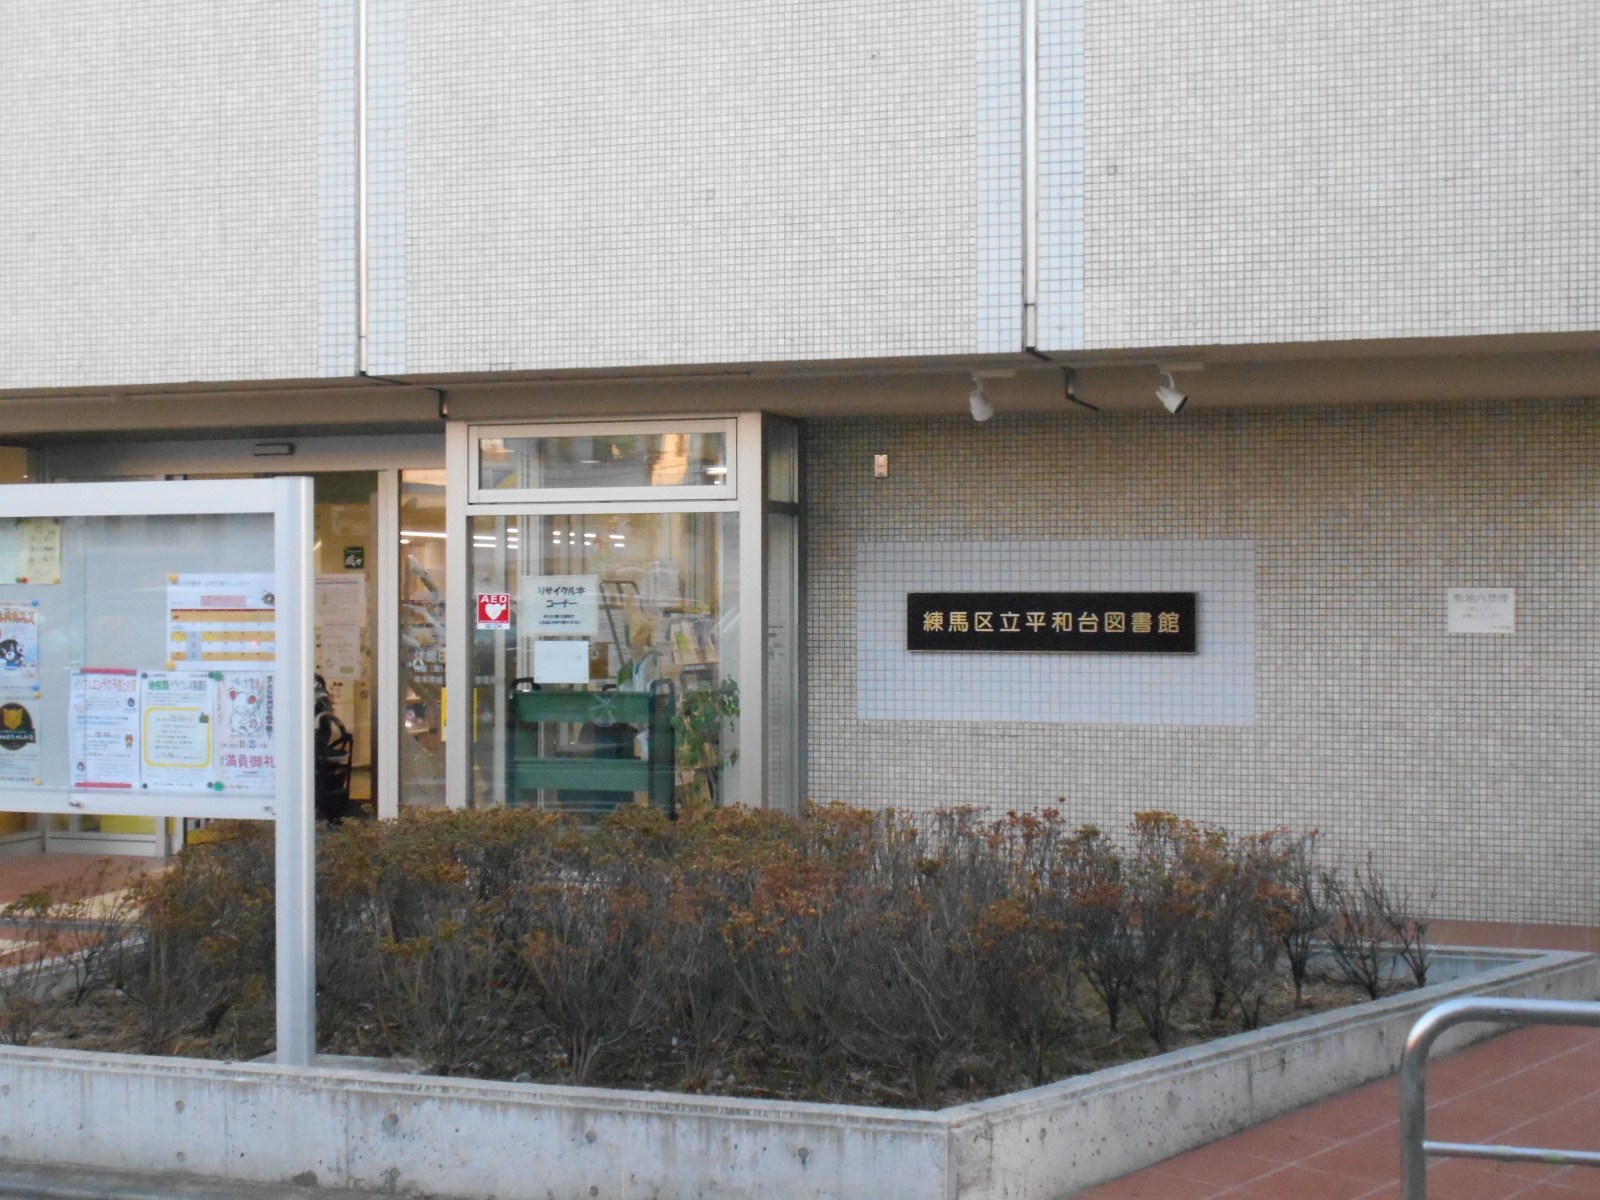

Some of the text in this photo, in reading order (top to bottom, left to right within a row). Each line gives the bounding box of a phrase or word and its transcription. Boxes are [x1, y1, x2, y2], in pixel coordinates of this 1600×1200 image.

[538, 586, 586, 595] リサイクル本
[480, 595, 507, 603] AED
[546, 599, 578, 608] コーナー
[922, 611, 1181, 633] 練馬区立平和台図書館
